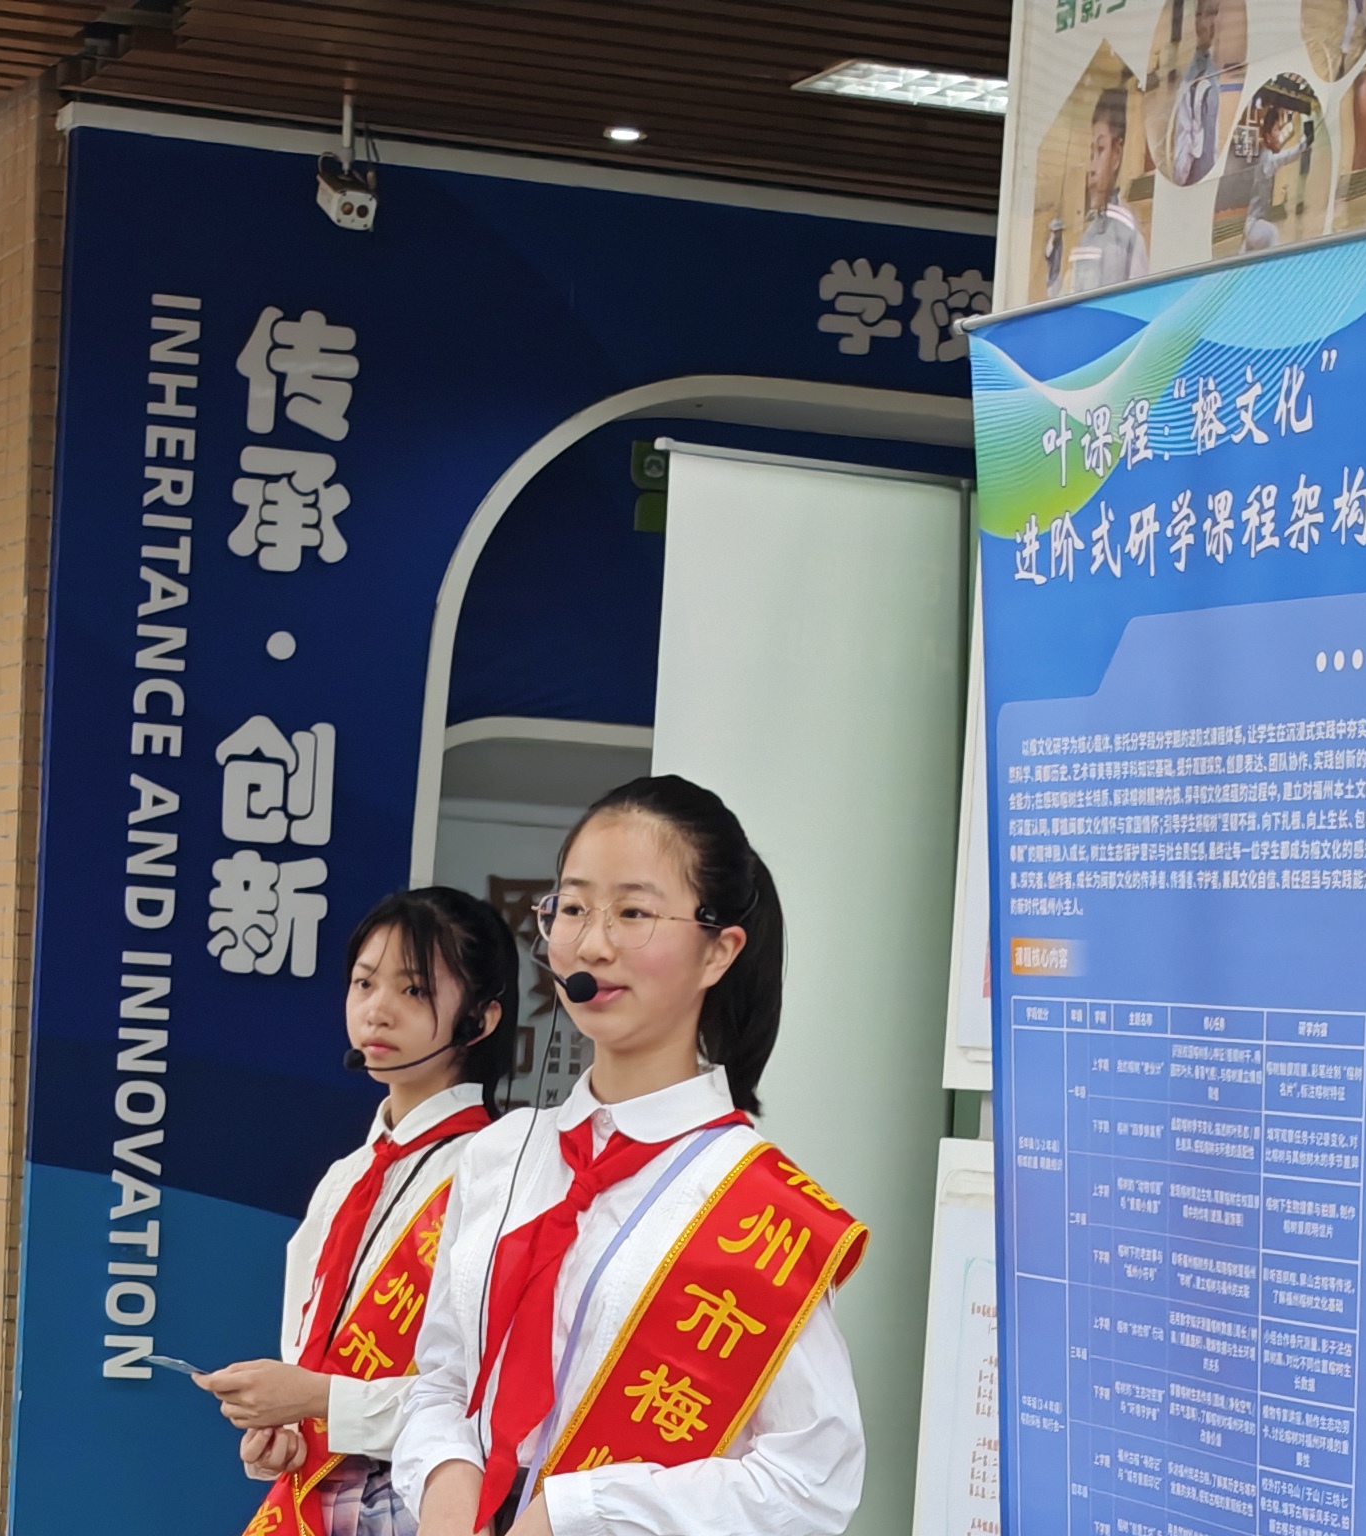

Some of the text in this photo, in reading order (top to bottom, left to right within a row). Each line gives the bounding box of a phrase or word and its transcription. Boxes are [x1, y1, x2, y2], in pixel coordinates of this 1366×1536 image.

[102, 293, 202, 1380] INHERITANCE AND INNOVATION
